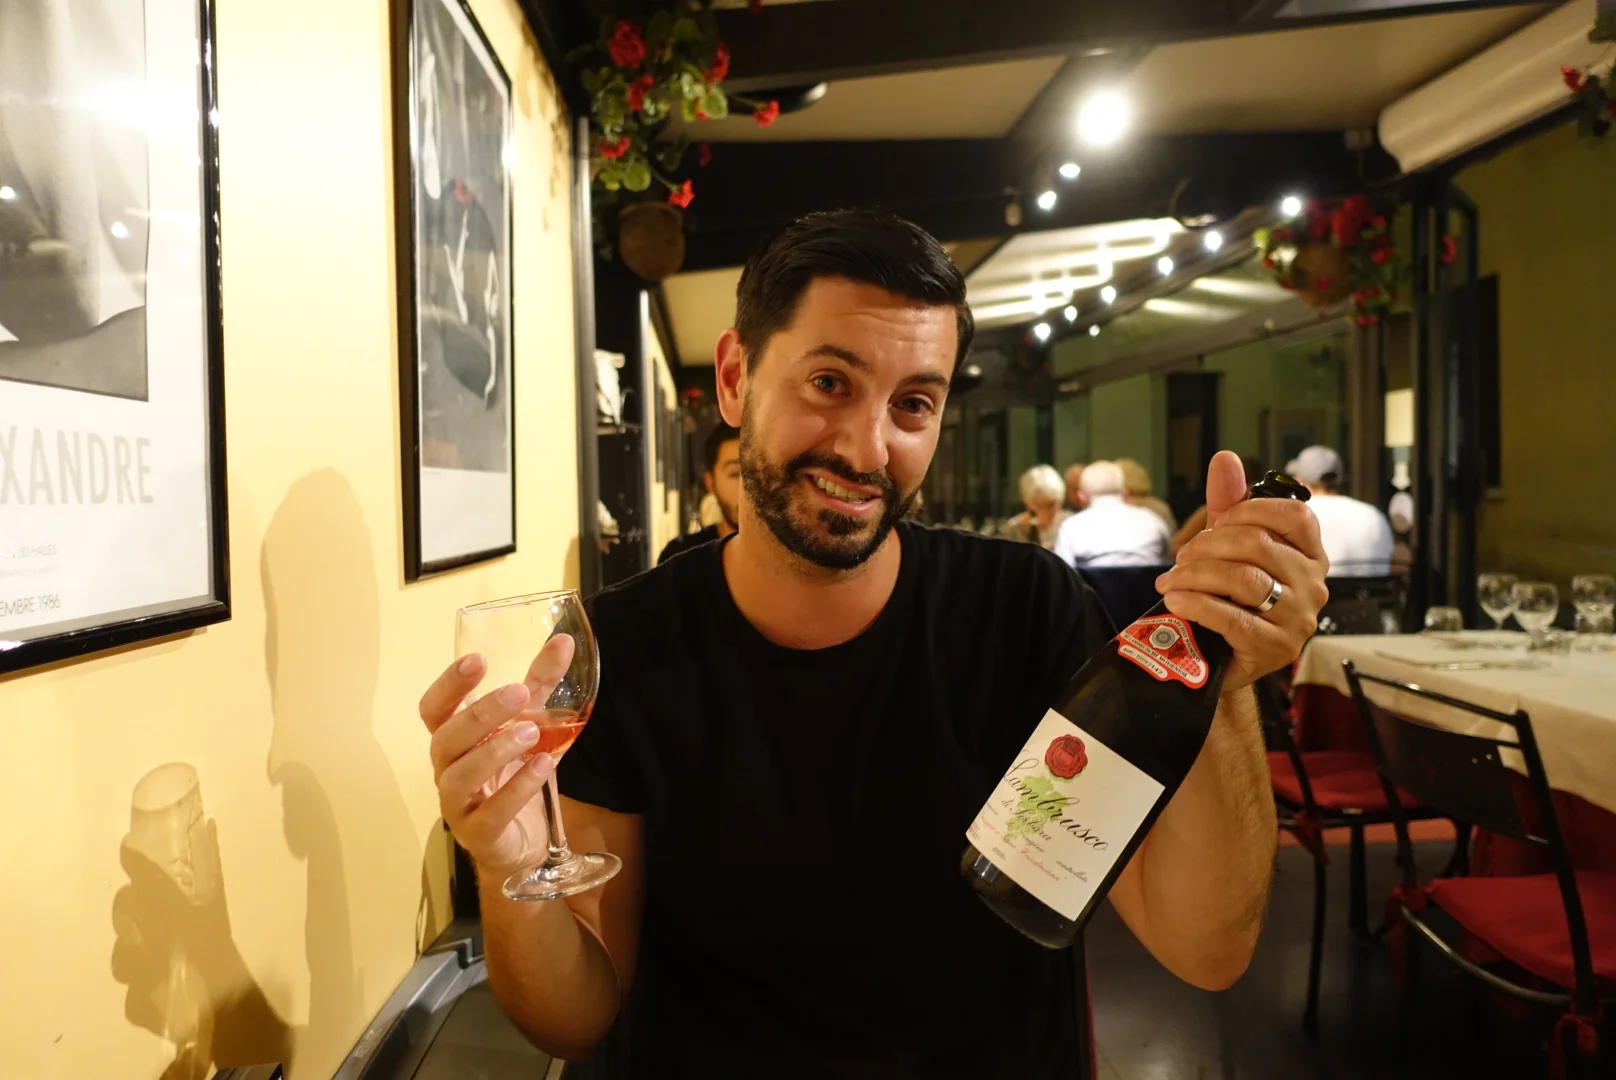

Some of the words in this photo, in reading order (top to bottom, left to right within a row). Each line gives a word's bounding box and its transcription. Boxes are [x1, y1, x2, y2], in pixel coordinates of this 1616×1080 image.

[0, 425, 154, 505] XANDRE
[0, 596, 36, 617] EMBRE
[37, 592, 61, 611] 1986
[1003, 757, 1108, 851] Lambrusco
